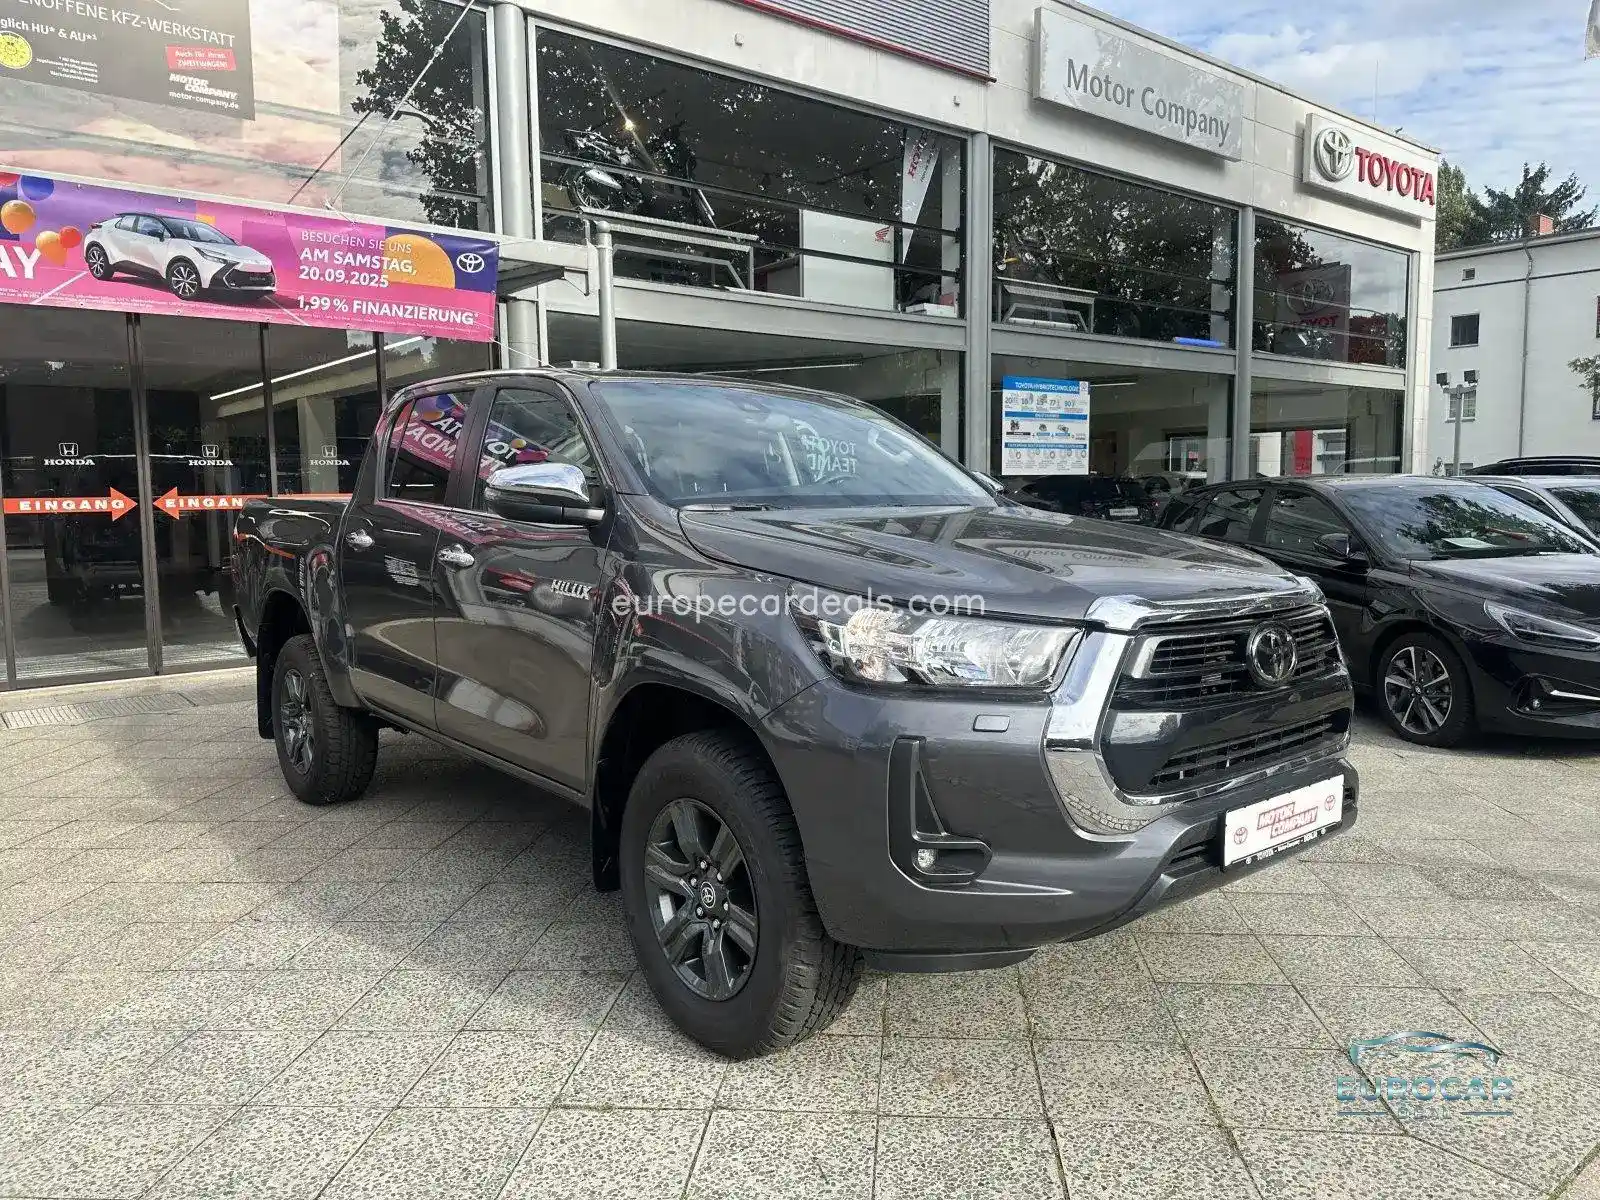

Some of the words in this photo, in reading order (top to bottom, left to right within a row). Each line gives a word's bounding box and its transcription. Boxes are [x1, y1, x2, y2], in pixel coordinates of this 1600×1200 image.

[58, 28, 68, 39] &
[112, 9, 235, 47] KFZ-WERKSTATT
[169, 73, 209, 86] MOTOR
[169, 91, 239, 109] motor-company.de
[185, 84, 238, 99] COMPANY
[1067, 58, 1135, 108] Motor
[1141, 86, 1230, 147] Company
[1355, 146, 1435, 206] TOYOTA
[301, 230, 366, 249] BESUCHEN
[368, 239, 386, 251] SIE
[388, 242, 412, 254] UNS
[300, 247, 329, 263] AM
[333, 251, 418, 276] SAMSTAG,
[298, 265, 389, 288] 20.09.2025
[297, 295, 331, 312] 1,99
[333, 298, 348, 313] %
[44, 458, 96, 466] HONDA
[19, 500, 125, 511] EINGANG
[551, 579, 591, 600] HILUX
[1258, 804, 1295, 829] MOTOR
[1271, 808, 1318, 838] COMPANY
